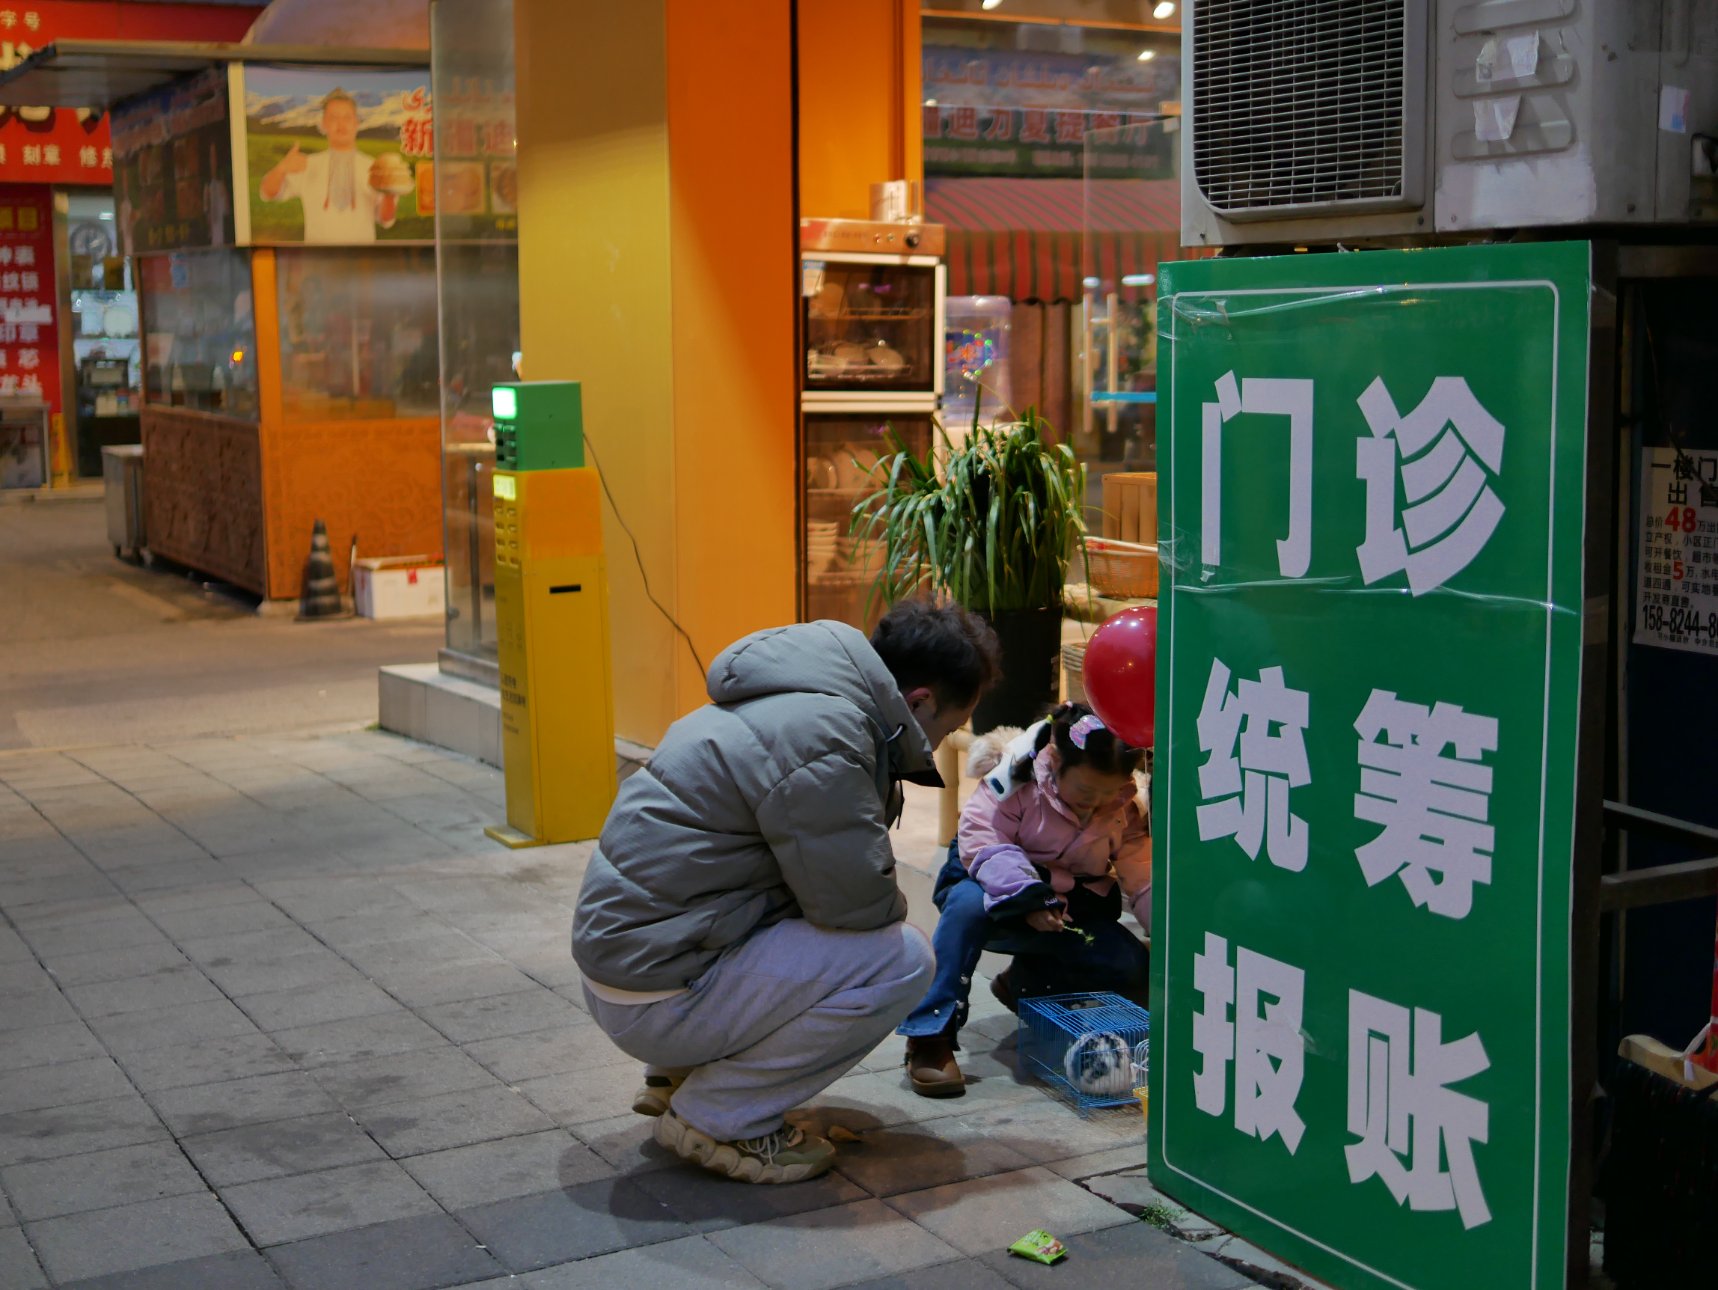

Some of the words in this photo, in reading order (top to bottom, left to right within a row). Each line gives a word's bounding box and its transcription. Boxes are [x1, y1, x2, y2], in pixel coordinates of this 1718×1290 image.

[1201, 369, 1506, 598] 门诊
[1642, 604, 1718, 638] 158-8244-8
[1196, 657, 1499, 919] 统筹
[1192, 931, 1492, 1230] 报账
